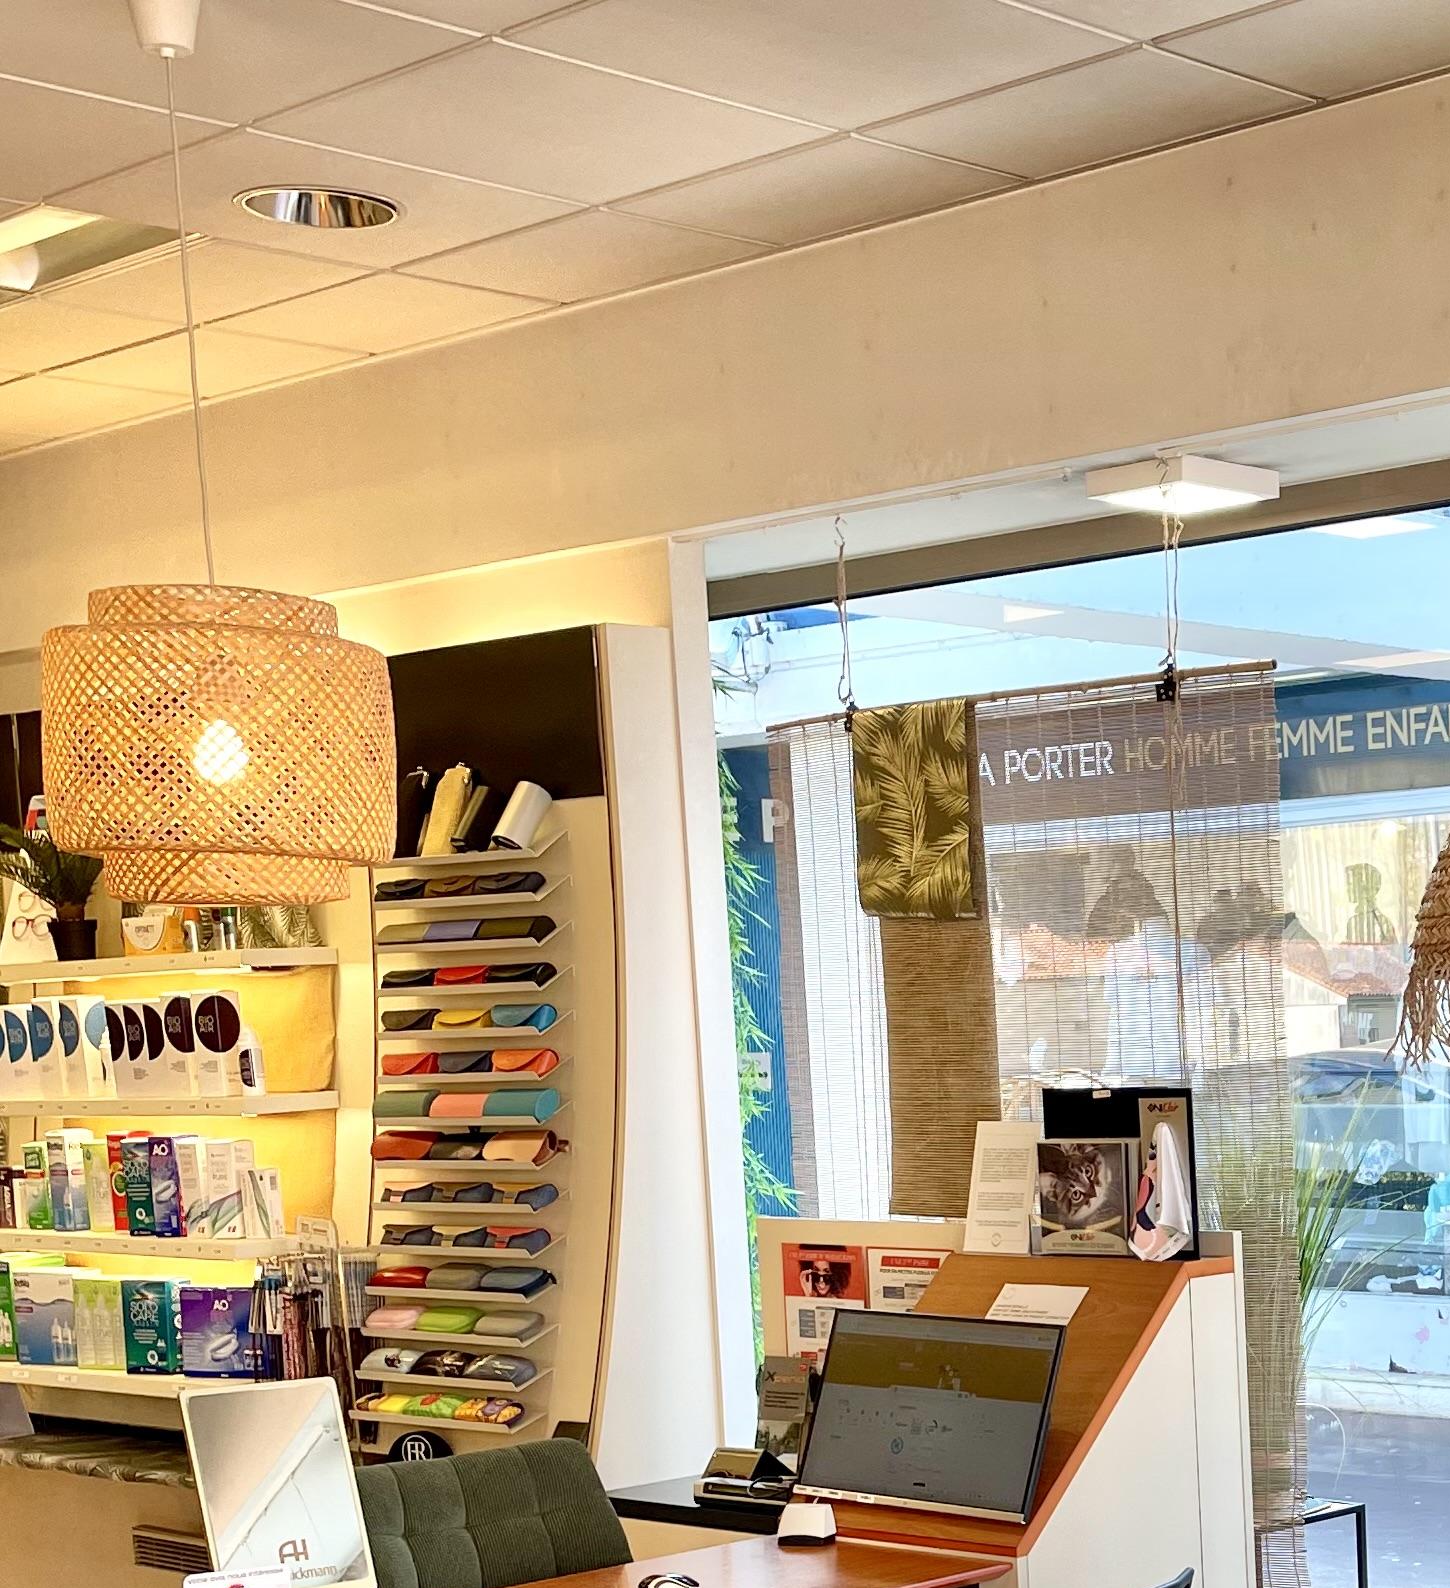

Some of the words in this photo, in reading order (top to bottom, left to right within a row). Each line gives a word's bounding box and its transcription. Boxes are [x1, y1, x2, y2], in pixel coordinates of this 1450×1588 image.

[1003, 741, 1115, 785] PORTER
[1123, 729, 1237, 773] HOMME
[1249, 714, 1355, 762] FEMME
[291, 1564, 337, 1581] ickmann
